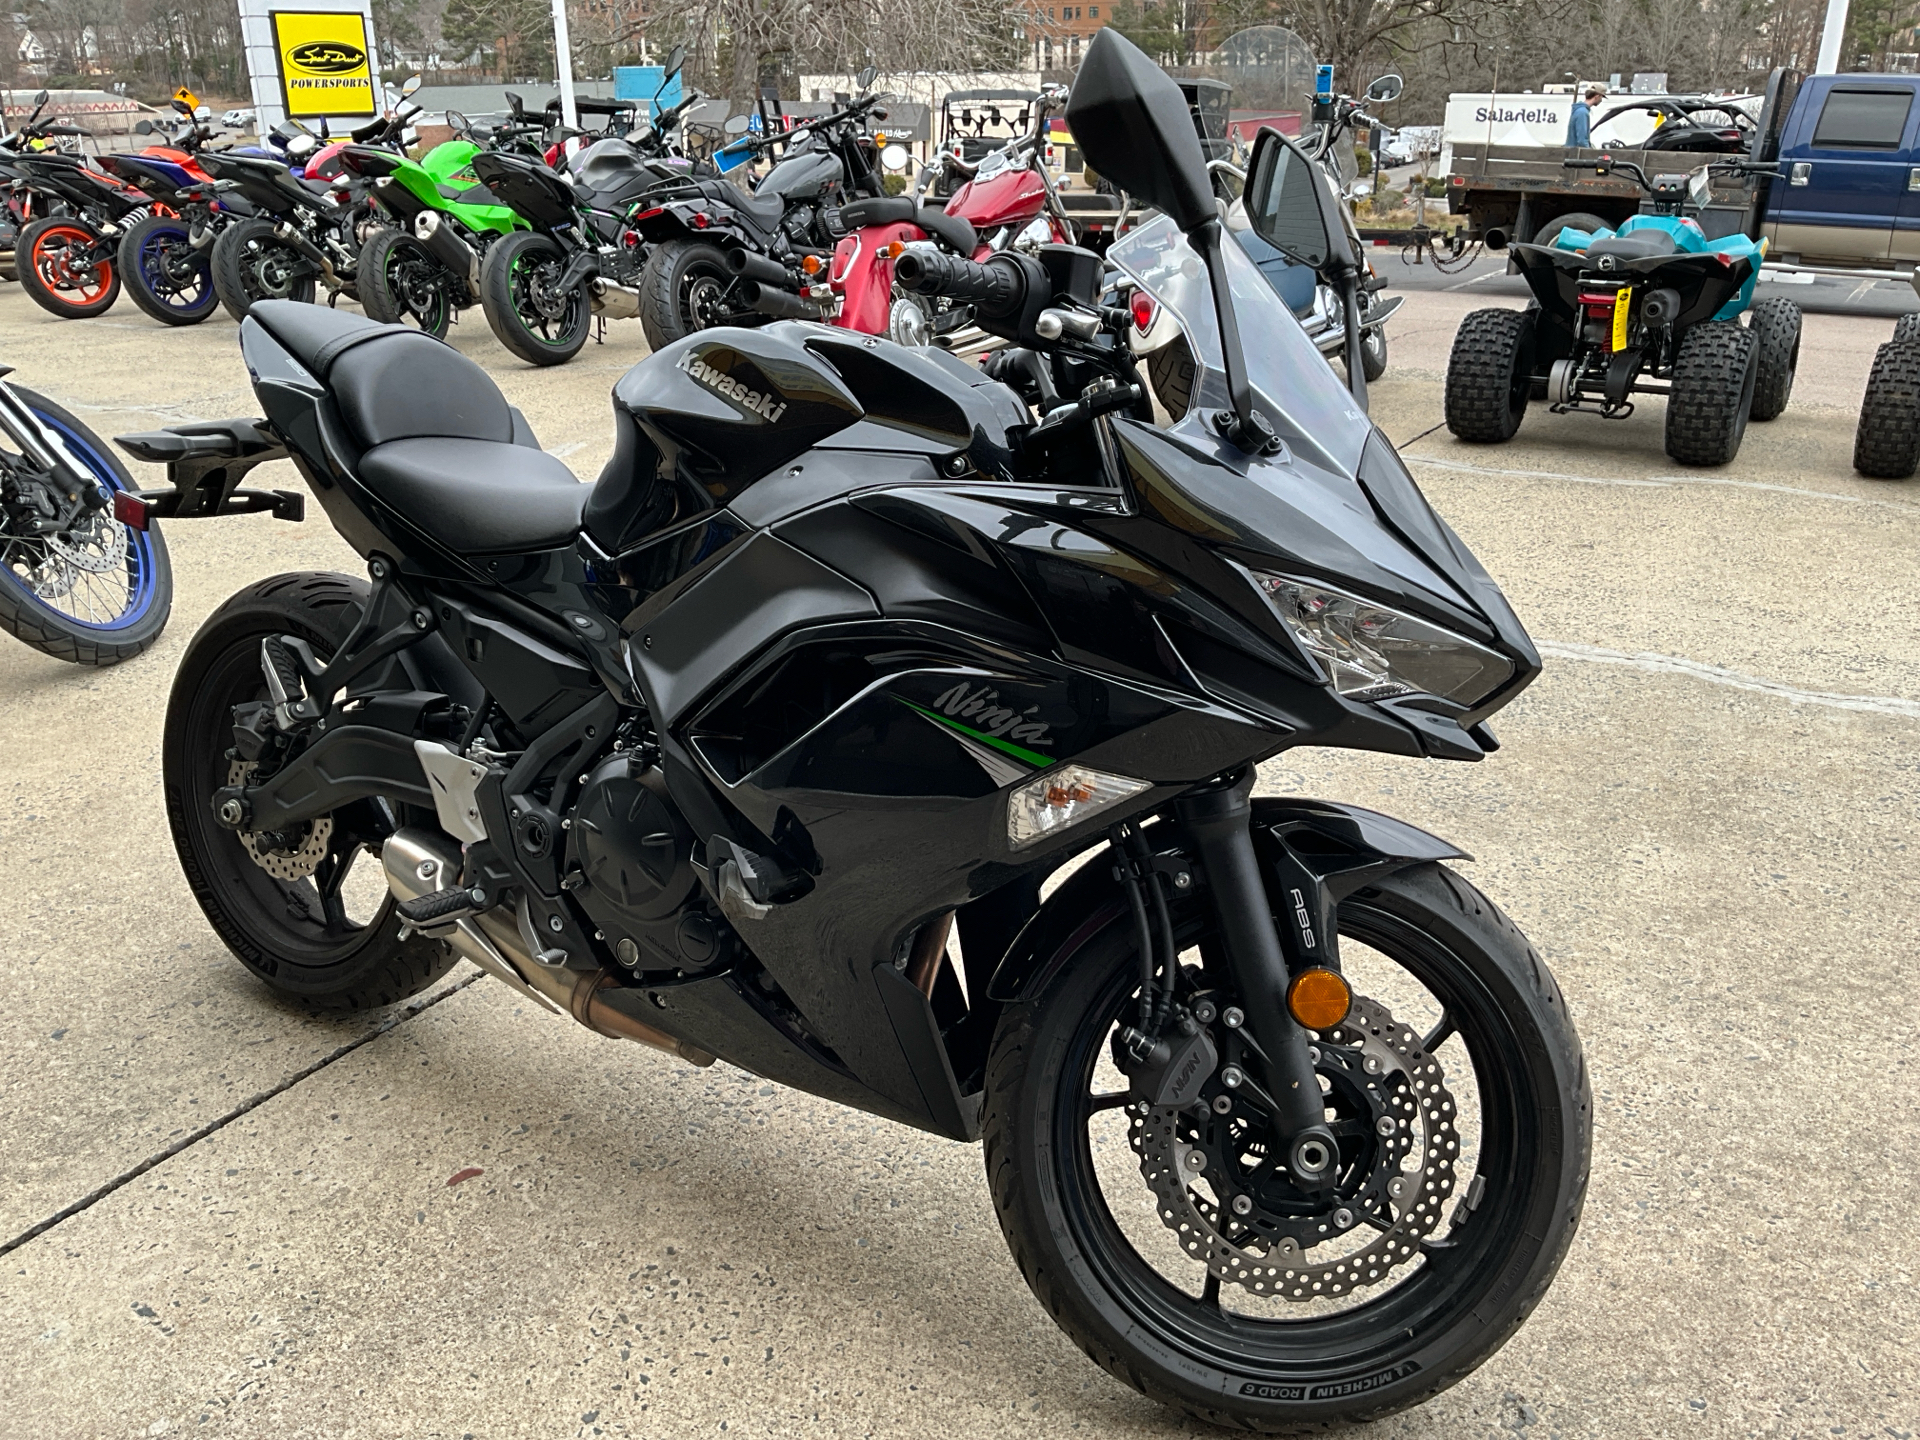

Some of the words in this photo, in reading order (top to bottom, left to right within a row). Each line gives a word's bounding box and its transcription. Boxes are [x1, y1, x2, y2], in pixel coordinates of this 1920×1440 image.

[291, 78, 369, 89] POWERSPORTS
[675, 349, 788, 424] Kawasaki
[932, 681, 1054, 745] Ninja
[204, 898, 260, 963] MICHELIN
[1290, 888, 1316, 949] ABS
[1244, 1384, 1255, 1394] 6
[1259, 1386, 1300, 1398] ROAD
[1316, 1371, 1392, 1397] MICHELIN
